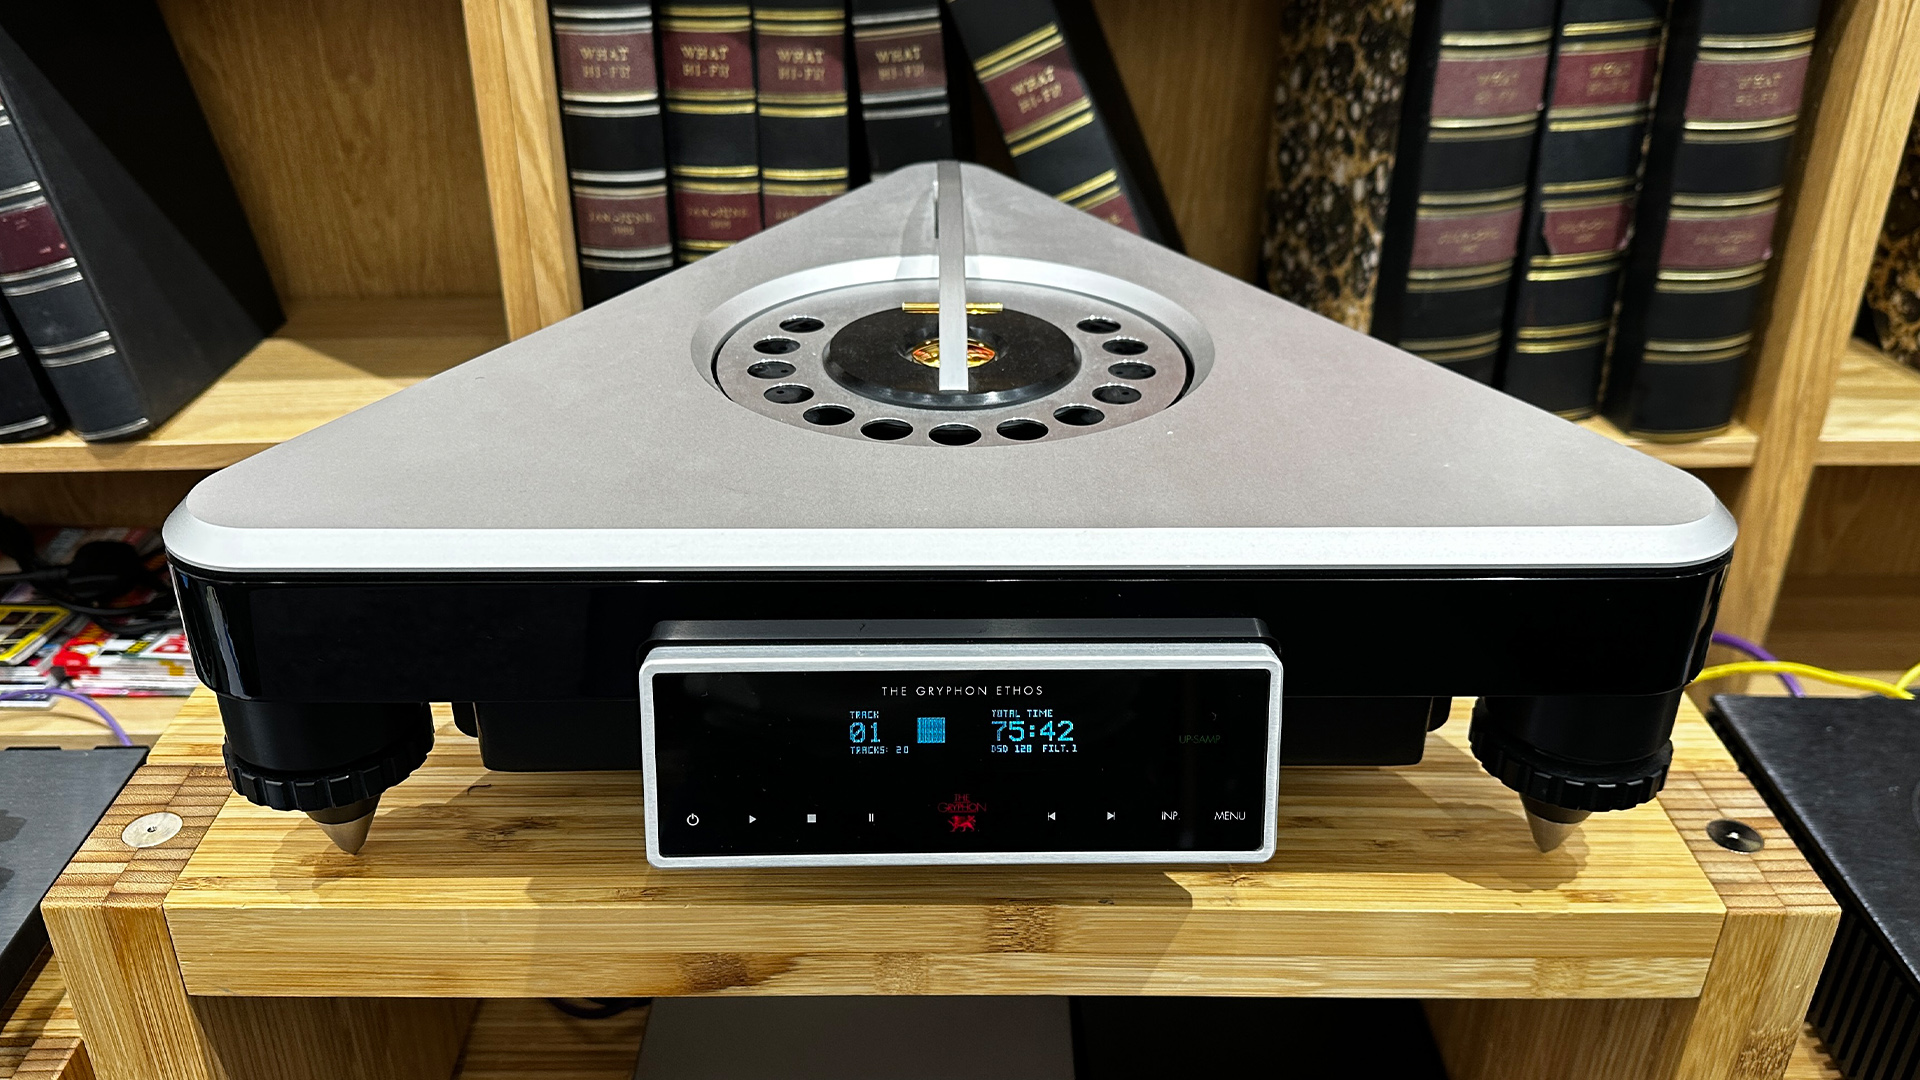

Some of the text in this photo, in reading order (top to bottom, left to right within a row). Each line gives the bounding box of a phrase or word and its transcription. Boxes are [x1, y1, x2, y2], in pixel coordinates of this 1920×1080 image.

[580, 45, 629, 61] WHAT
[680, 44, 729, 61] WHAT
[776, 48, 825, 64] WHAT
[875, 44, 922, 64] WHAT
[1010, 65, 1055, 97] WHAT
[882, 685, 1043, 697] THE GRYPHON ETHOS
[849, 710, 879, 719] TRACK
[991, 709, 1053, 718] TOTAL TIME
[849, 722, 880, 743] 01
[991, 720, 1074, 742] 75:42
[850, 745, 909, 755] TRACKS: 20
[991, 744, 1009, 753] DSD
[954, 793, 970, 802] THE
[938, 802, 987, 813] GRYPHON
[1214, 810, 1246, 820] MENU
